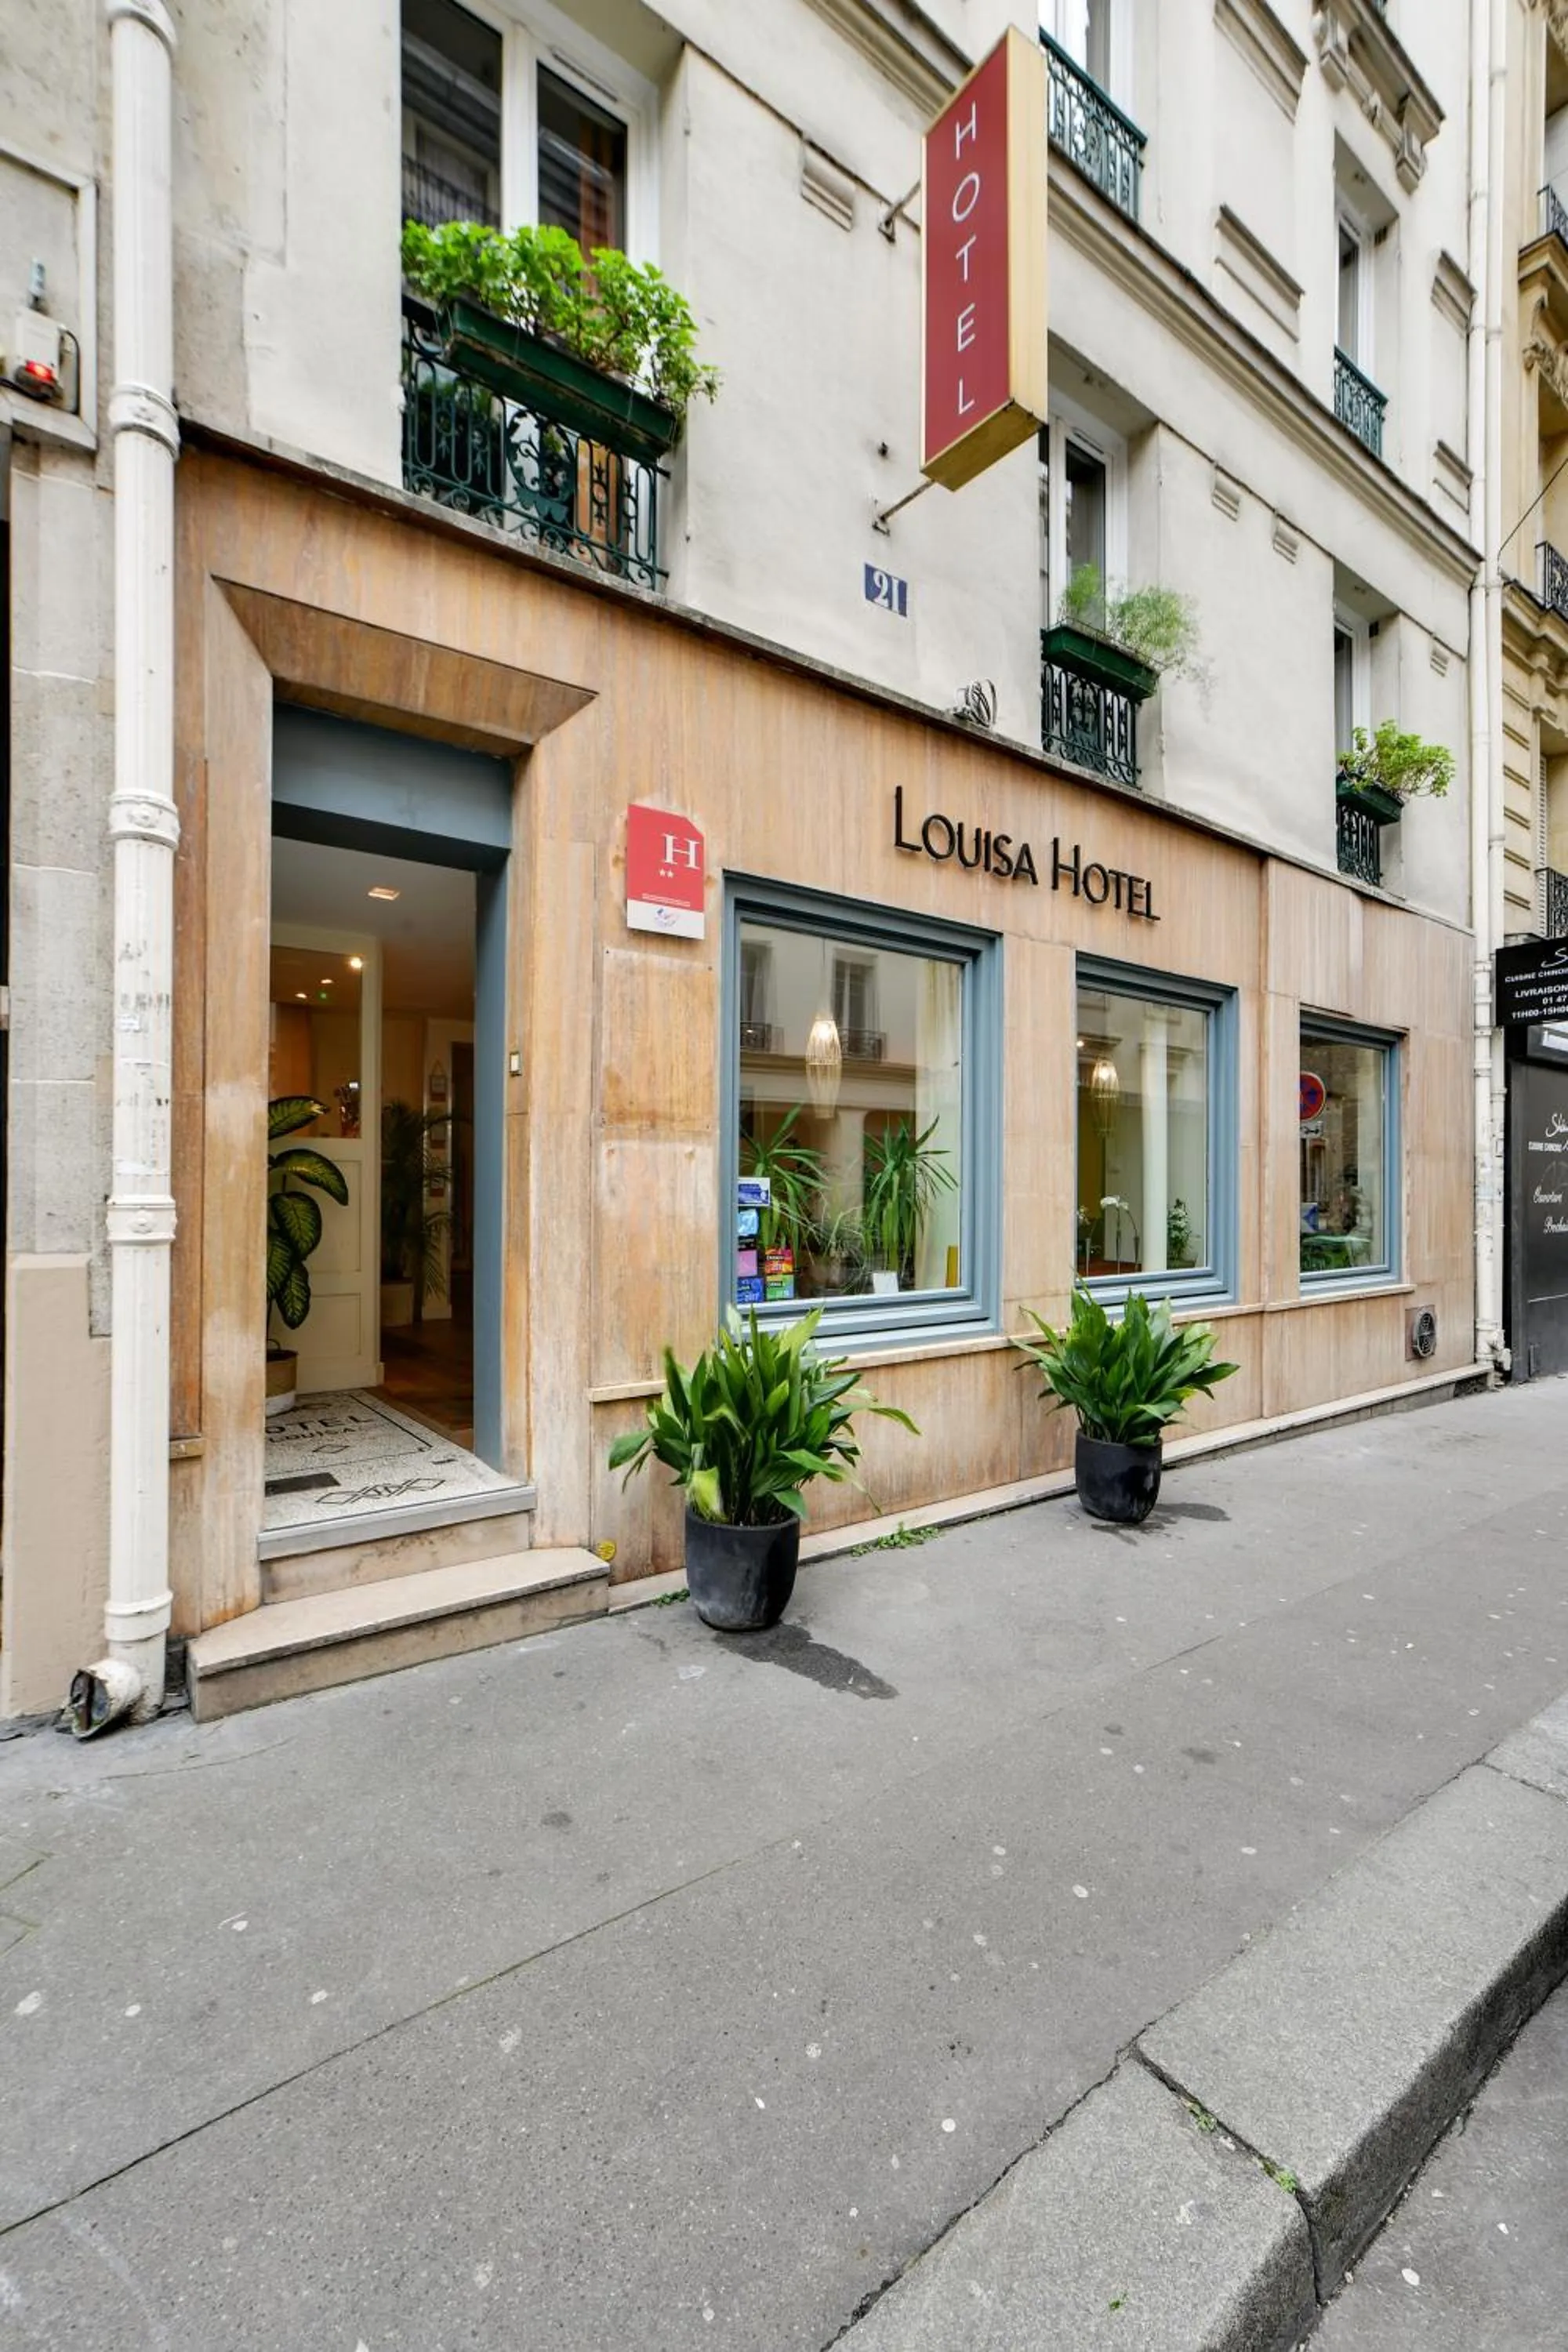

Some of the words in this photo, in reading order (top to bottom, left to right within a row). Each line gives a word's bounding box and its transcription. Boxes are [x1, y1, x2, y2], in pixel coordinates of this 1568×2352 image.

[952, 100, 980, 417] HOTEL
[873, 570, 900, 615] 21
[662, 833, 701, 870] H
[894, 785, 1039, 885] LOUISA
[1051, 837, 1162, 921] HOTEL
[265, 1415, 376, 1434] OTEL
[269, 1428, 357, 1443] LOUISA
